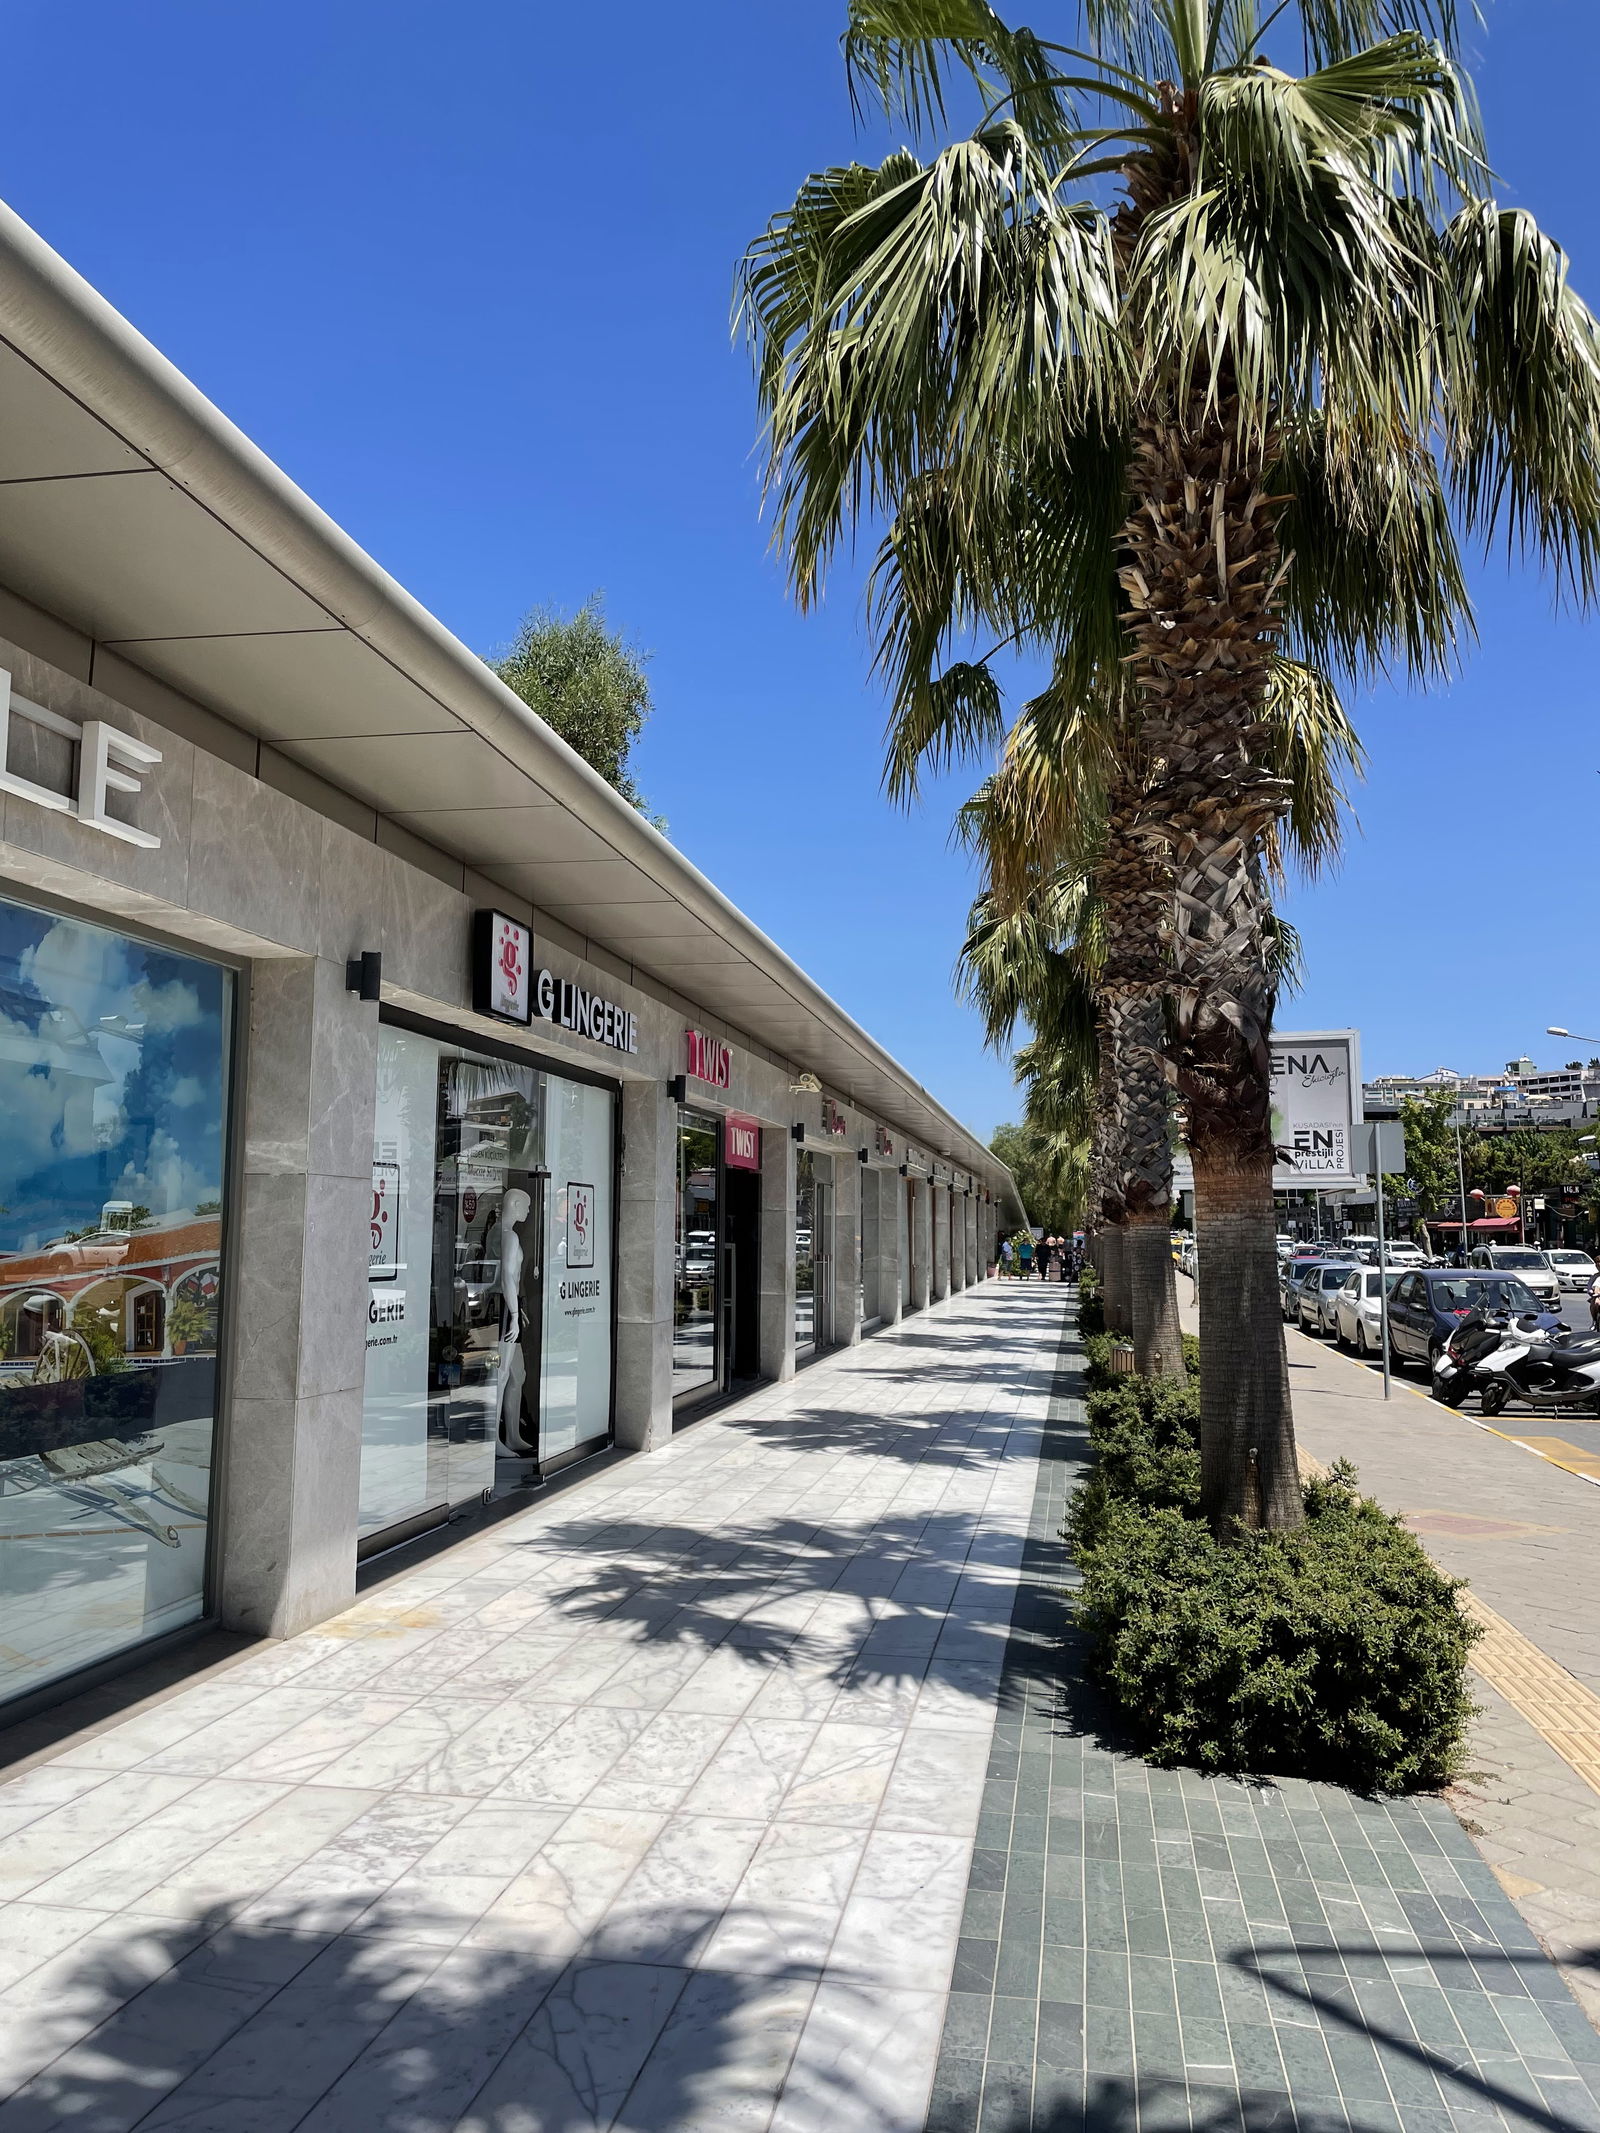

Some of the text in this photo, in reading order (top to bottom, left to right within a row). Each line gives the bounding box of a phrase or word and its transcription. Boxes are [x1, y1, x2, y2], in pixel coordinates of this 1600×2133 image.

[537, 968, 639, 1055] G LINGERIE
[690, 1030, 734, 1089] TWIST
[731, 1127, 755, 1159] TWIST
[1294, 1130, 1333, 1150] EN
[1295, 1148, 1334, 1159] prestijli
[1525, 1199, 1533, 1223] TAXI
[560, 1279, 600, 1300] G LINGERIE
